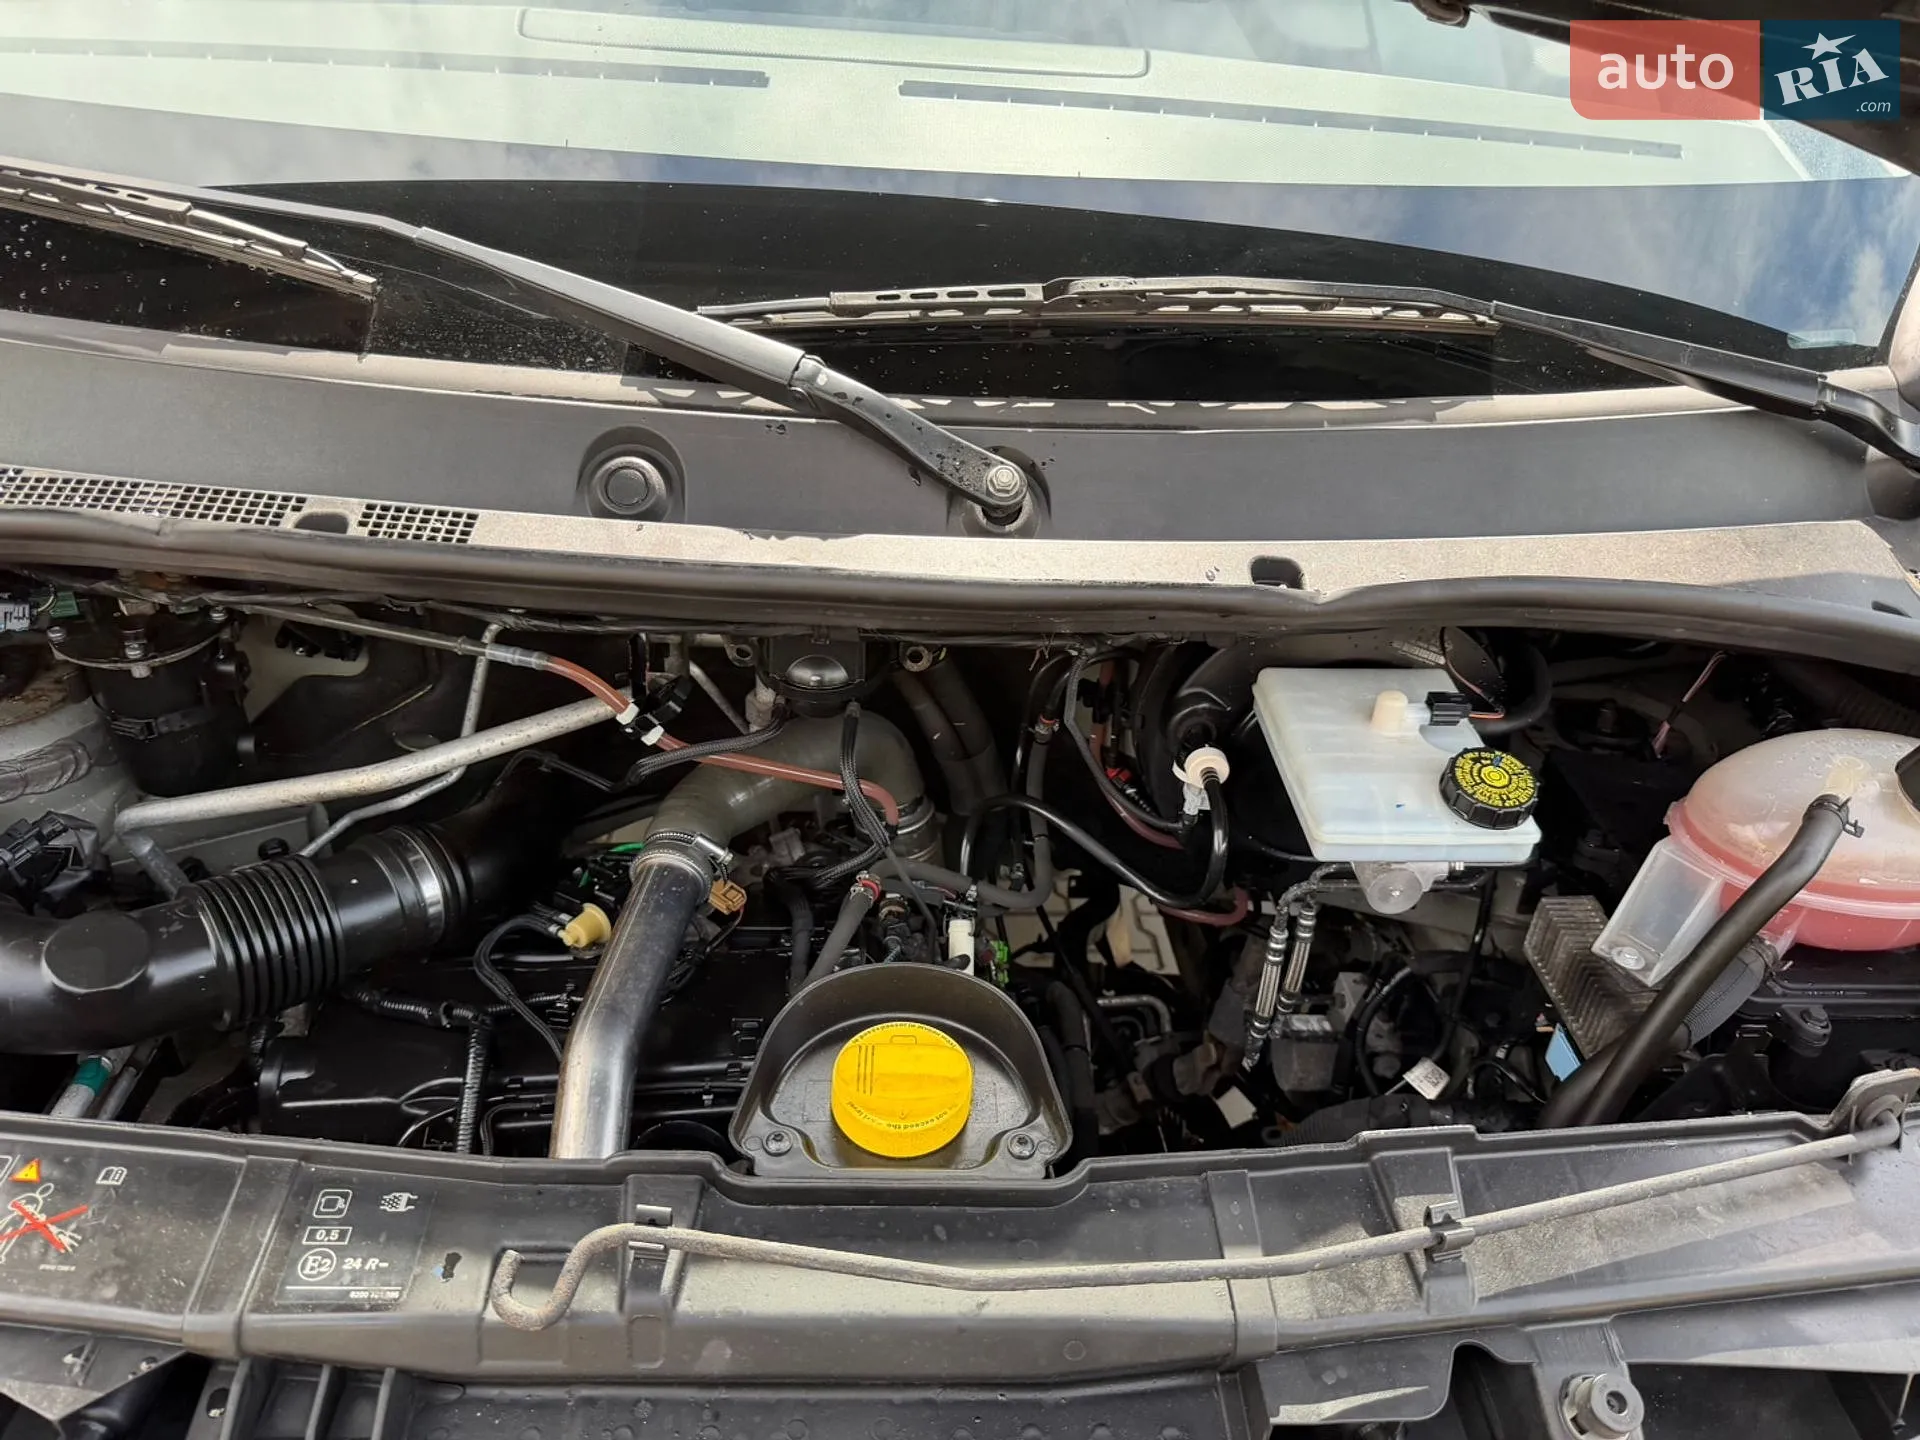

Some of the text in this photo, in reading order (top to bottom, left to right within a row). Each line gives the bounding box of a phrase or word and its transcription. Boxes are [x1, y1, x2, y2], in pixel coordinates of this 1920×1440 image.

[315, 1229, 341, 1242] 0,5
[302, 1255, 333, 1275] E2
[342, 1257, 363, 1270] 24
